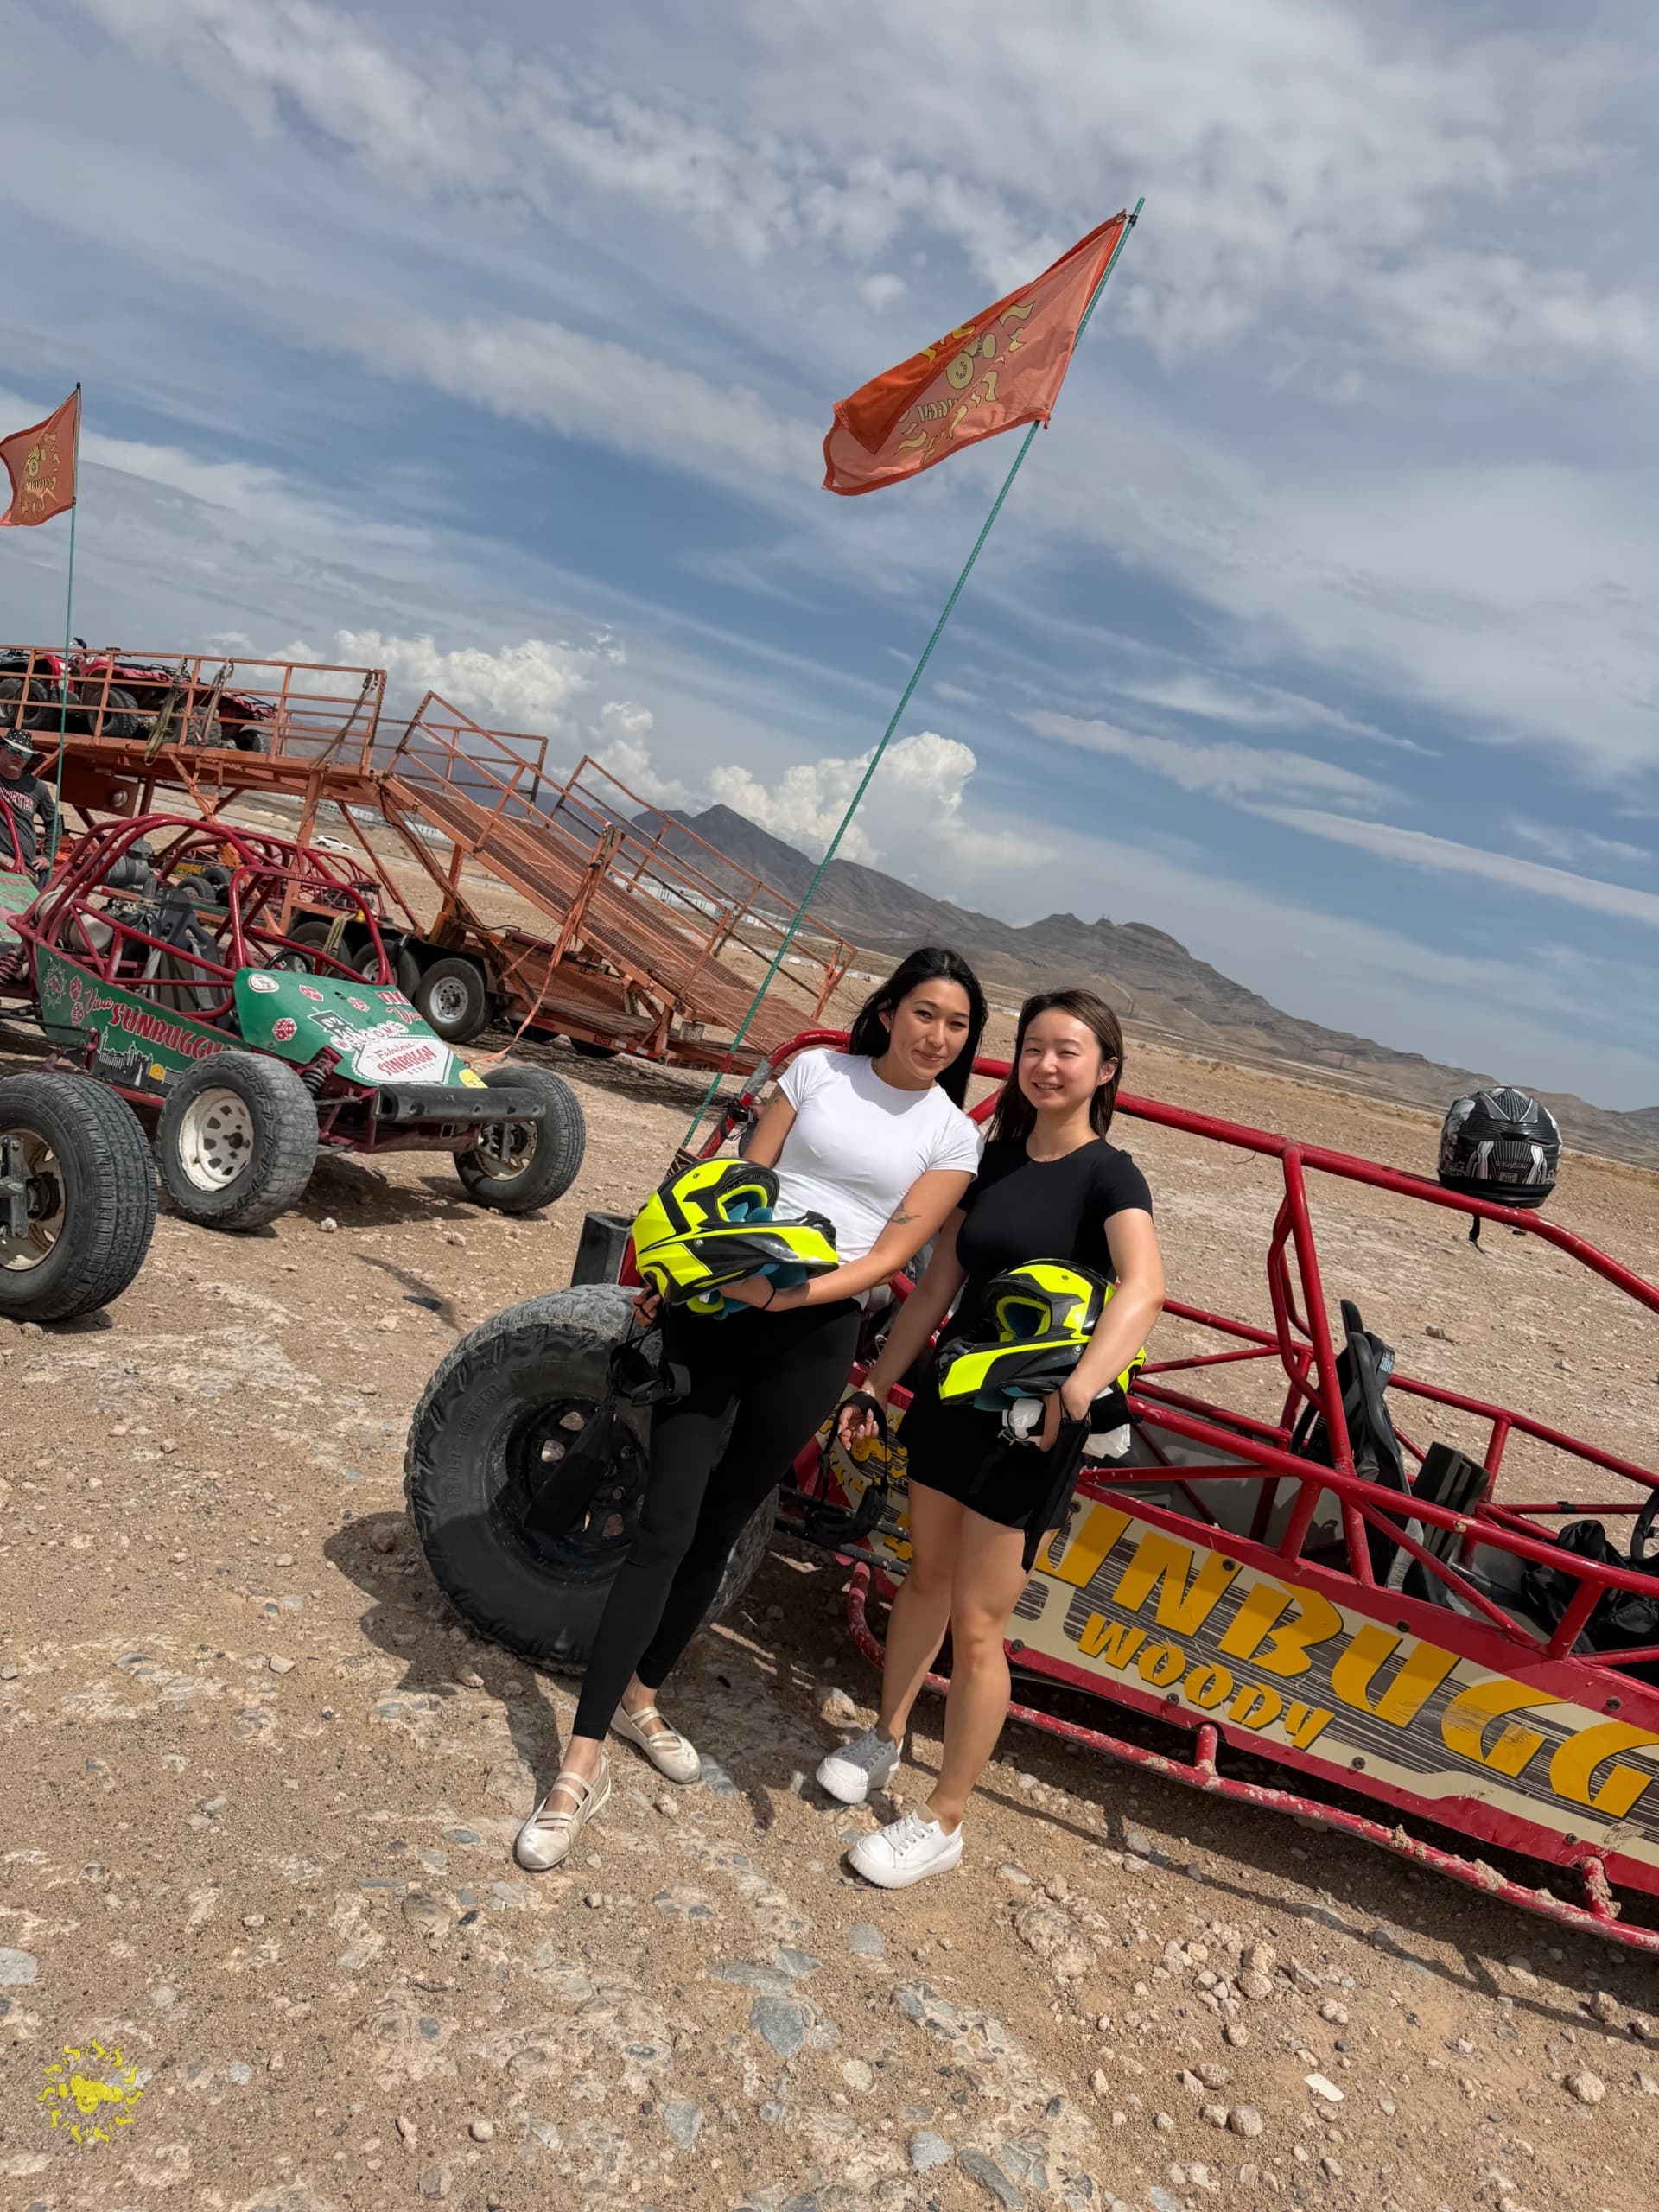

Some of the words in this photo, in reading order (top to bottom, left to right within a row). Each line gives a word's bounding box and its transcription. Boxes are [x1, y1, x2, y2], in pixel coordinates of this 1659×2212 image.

[85, 988, 113, 1013] Viva
[333, 1021, 406, 1050] WELCOME
[1035, 1503, 1659, 1818] UNBUGG
[1077, 1612, 1336, 1751] WOODY
